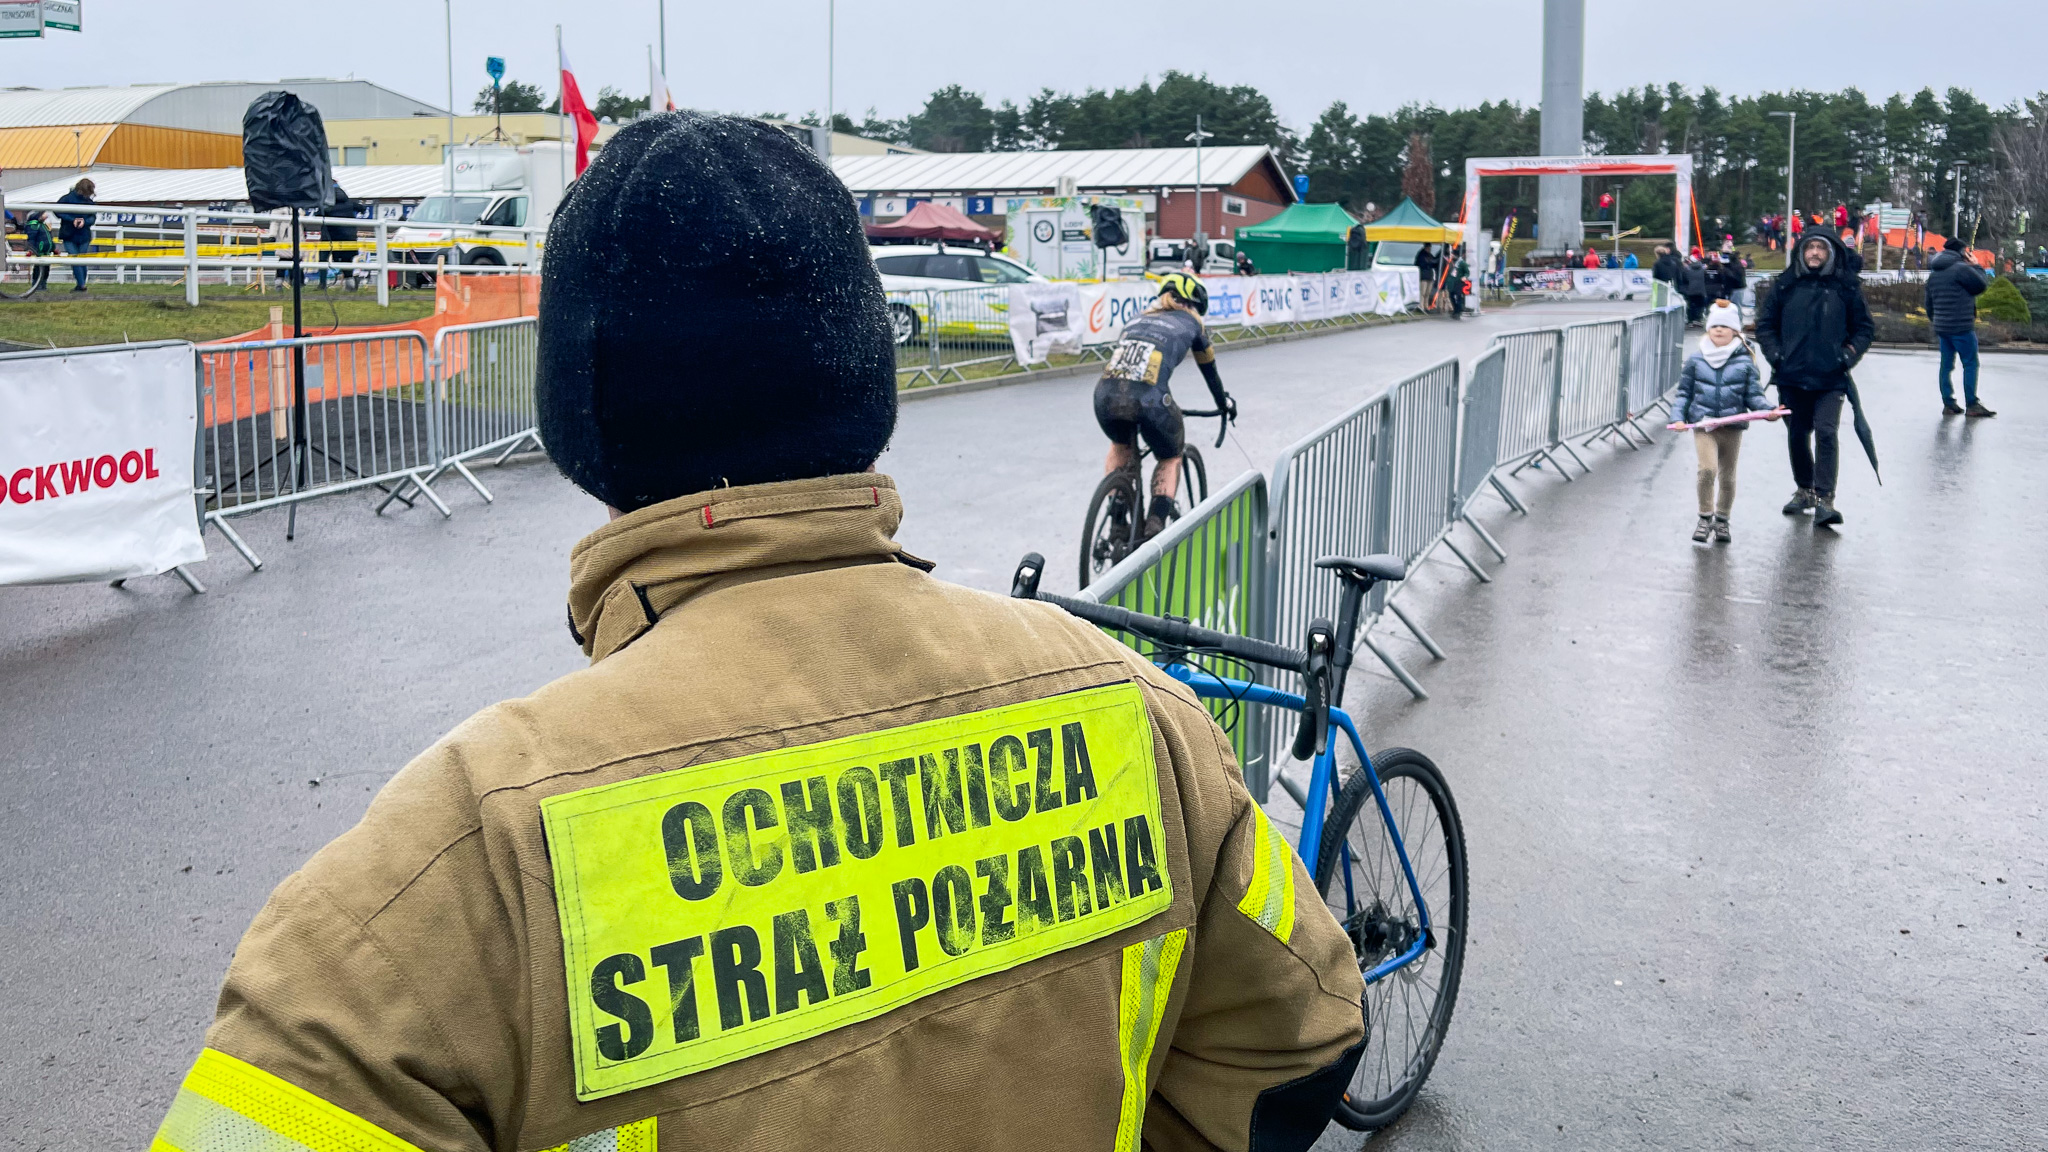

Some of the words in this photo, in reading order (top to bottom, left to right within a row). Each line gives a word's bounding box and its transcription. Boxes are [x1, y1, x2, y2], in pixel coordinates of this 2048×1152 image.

[383, 206, 397, 218] 24
[886, 201, 894, 212] 6
[975, 199, 985, 212] 3
[1318, 676, 1327, 708] GRX
[661, 721, 1098, 902] OCHOTNICZA
[590, 894, 871, 1062] STRAŻ
[892, 814, 1162, 973] POŻARNA
